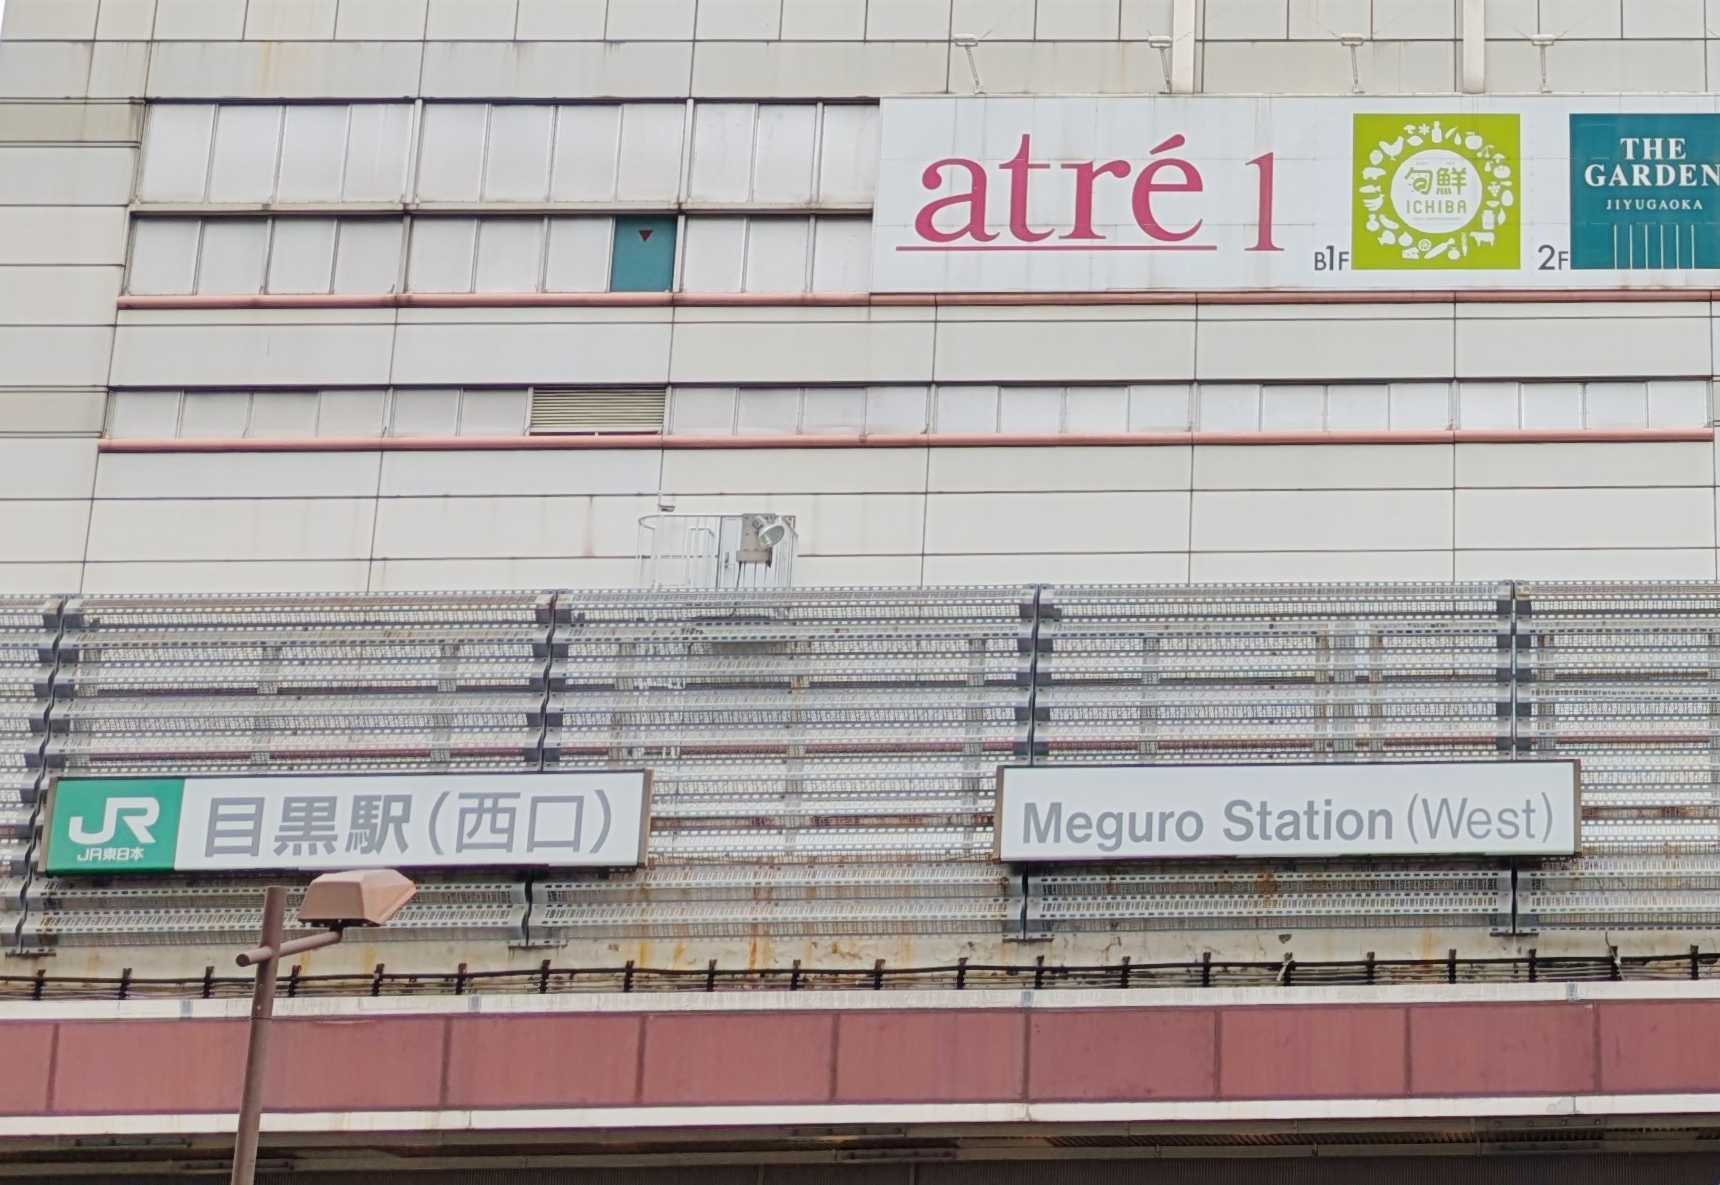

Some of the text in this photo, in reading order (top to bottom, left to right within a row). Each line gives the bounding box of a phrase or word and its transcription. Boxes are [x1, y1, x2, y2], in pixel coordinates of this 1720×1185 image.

[1620, 138, 1686, 160] THE
[913, 133, 1204, 242] atré
[1406, 200, 1466, 214] ICHIBA
[1605, 199, 1703, 211] JIYUGAOKA
[1314, 245, 1349, 270] B1F
[1537, 244, 1569, 270] 2F
[68, 797, 160, 845] JR
[1022, 791, 1553, 852] Meguro Station (West)
[77, 847, 144, 861] JR東日本
